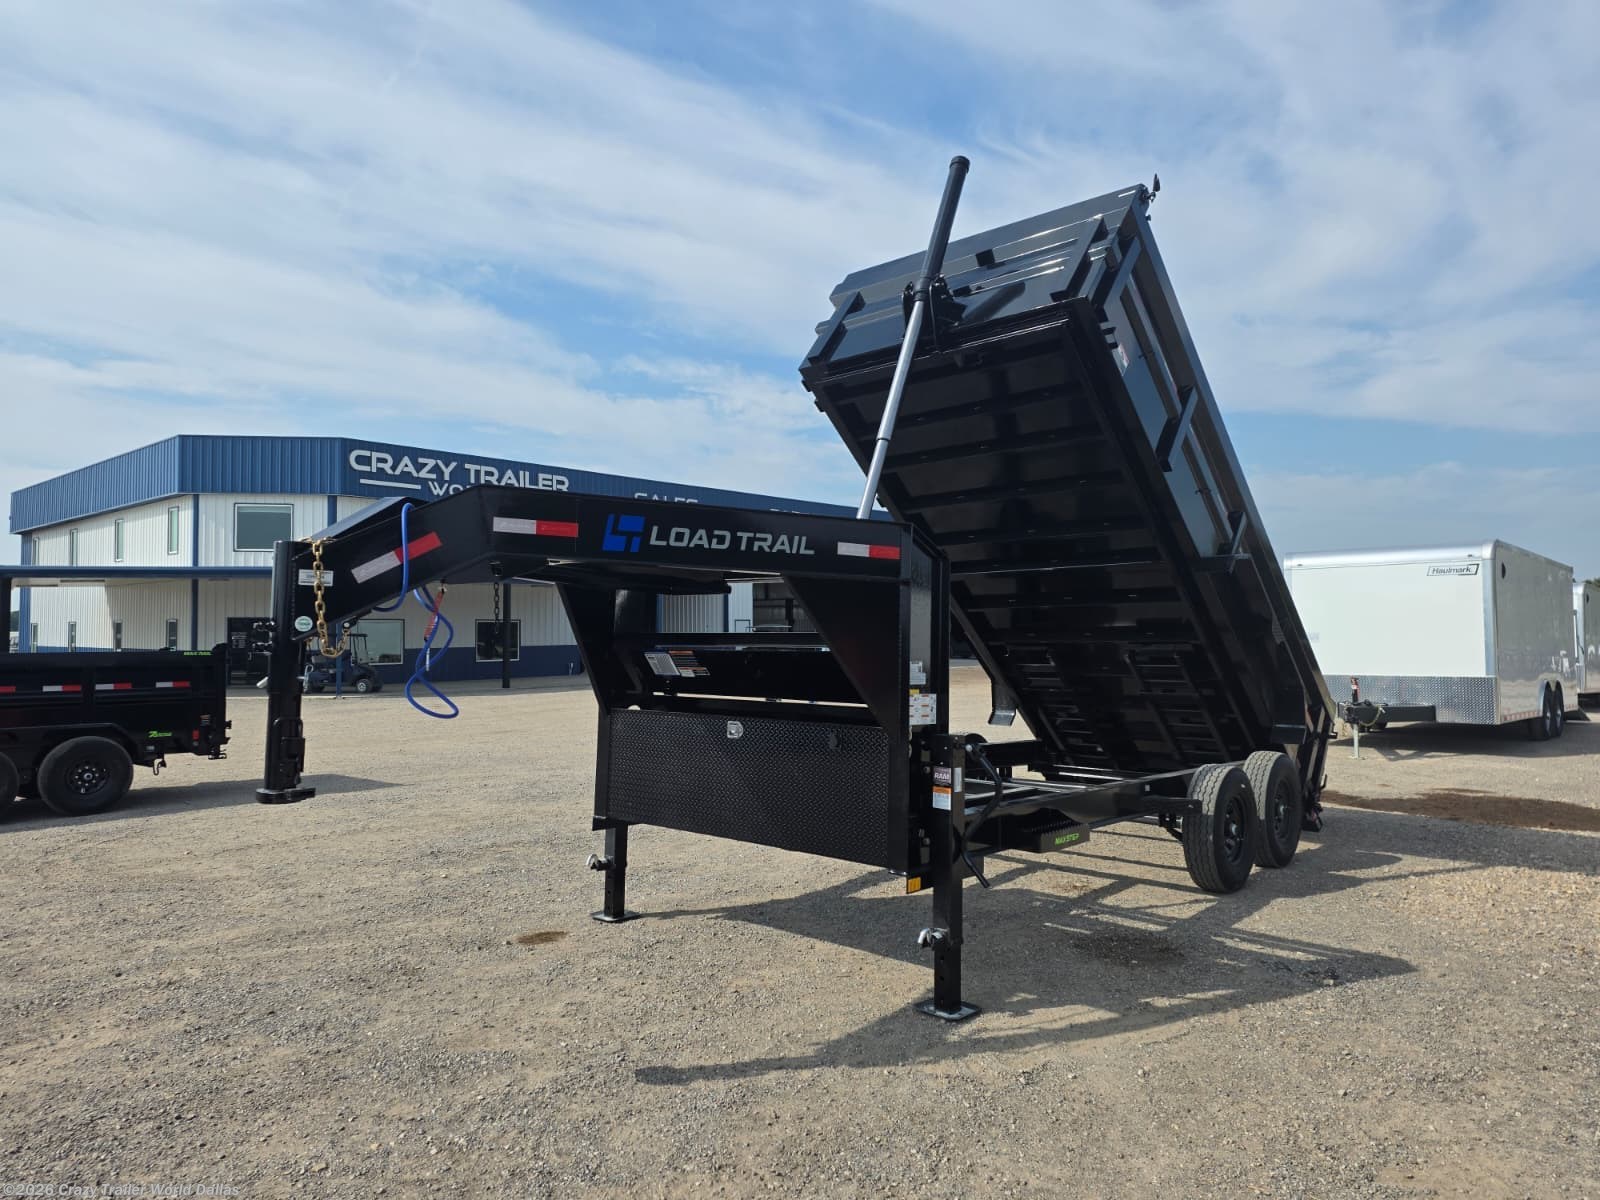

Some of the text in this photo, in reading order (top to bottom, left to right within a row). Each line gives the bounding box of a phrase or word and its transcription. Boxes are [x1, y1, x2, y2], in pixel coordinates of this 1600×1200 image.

[349, 449, 570, 492] CRAZY TRAILER
[649, 525, 816, 555] LOAD TRAIL
